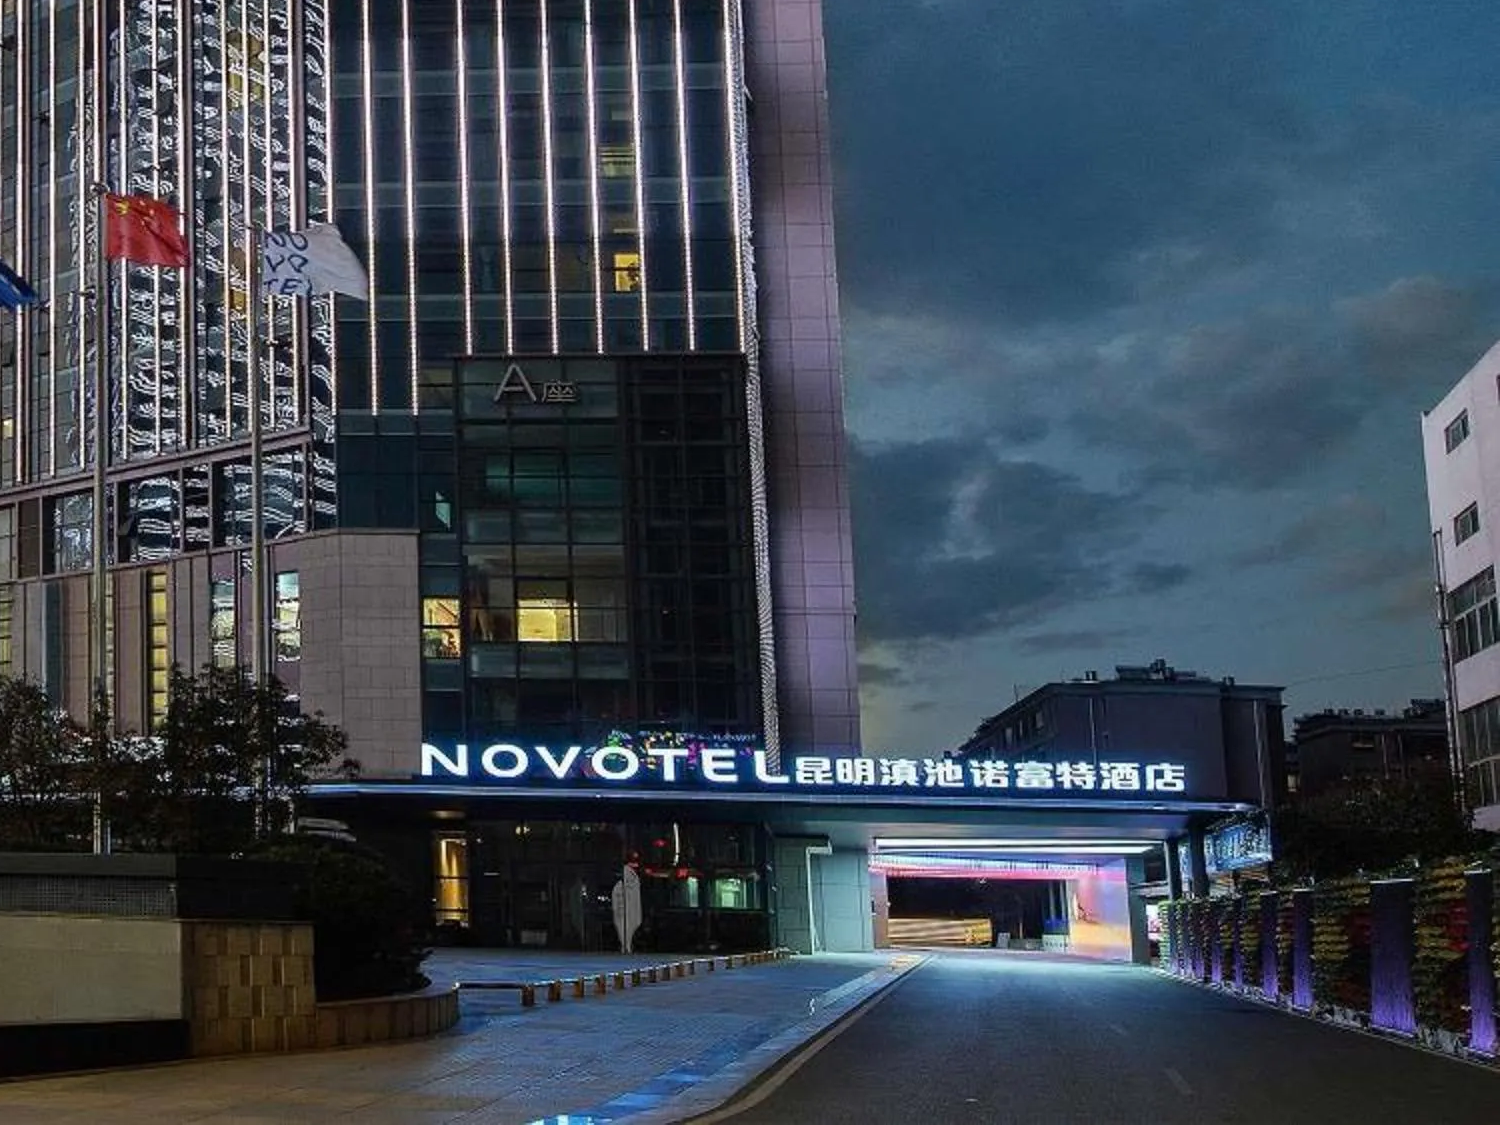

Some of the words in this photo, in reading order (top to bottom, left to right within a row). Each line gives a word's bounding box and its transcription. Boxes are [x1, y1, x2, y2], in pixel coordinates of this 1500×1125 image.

[420, 742, 790, 784] NOVOTEL
[795, 756, 1186, 792] 昆明滇池诺富特酒店
